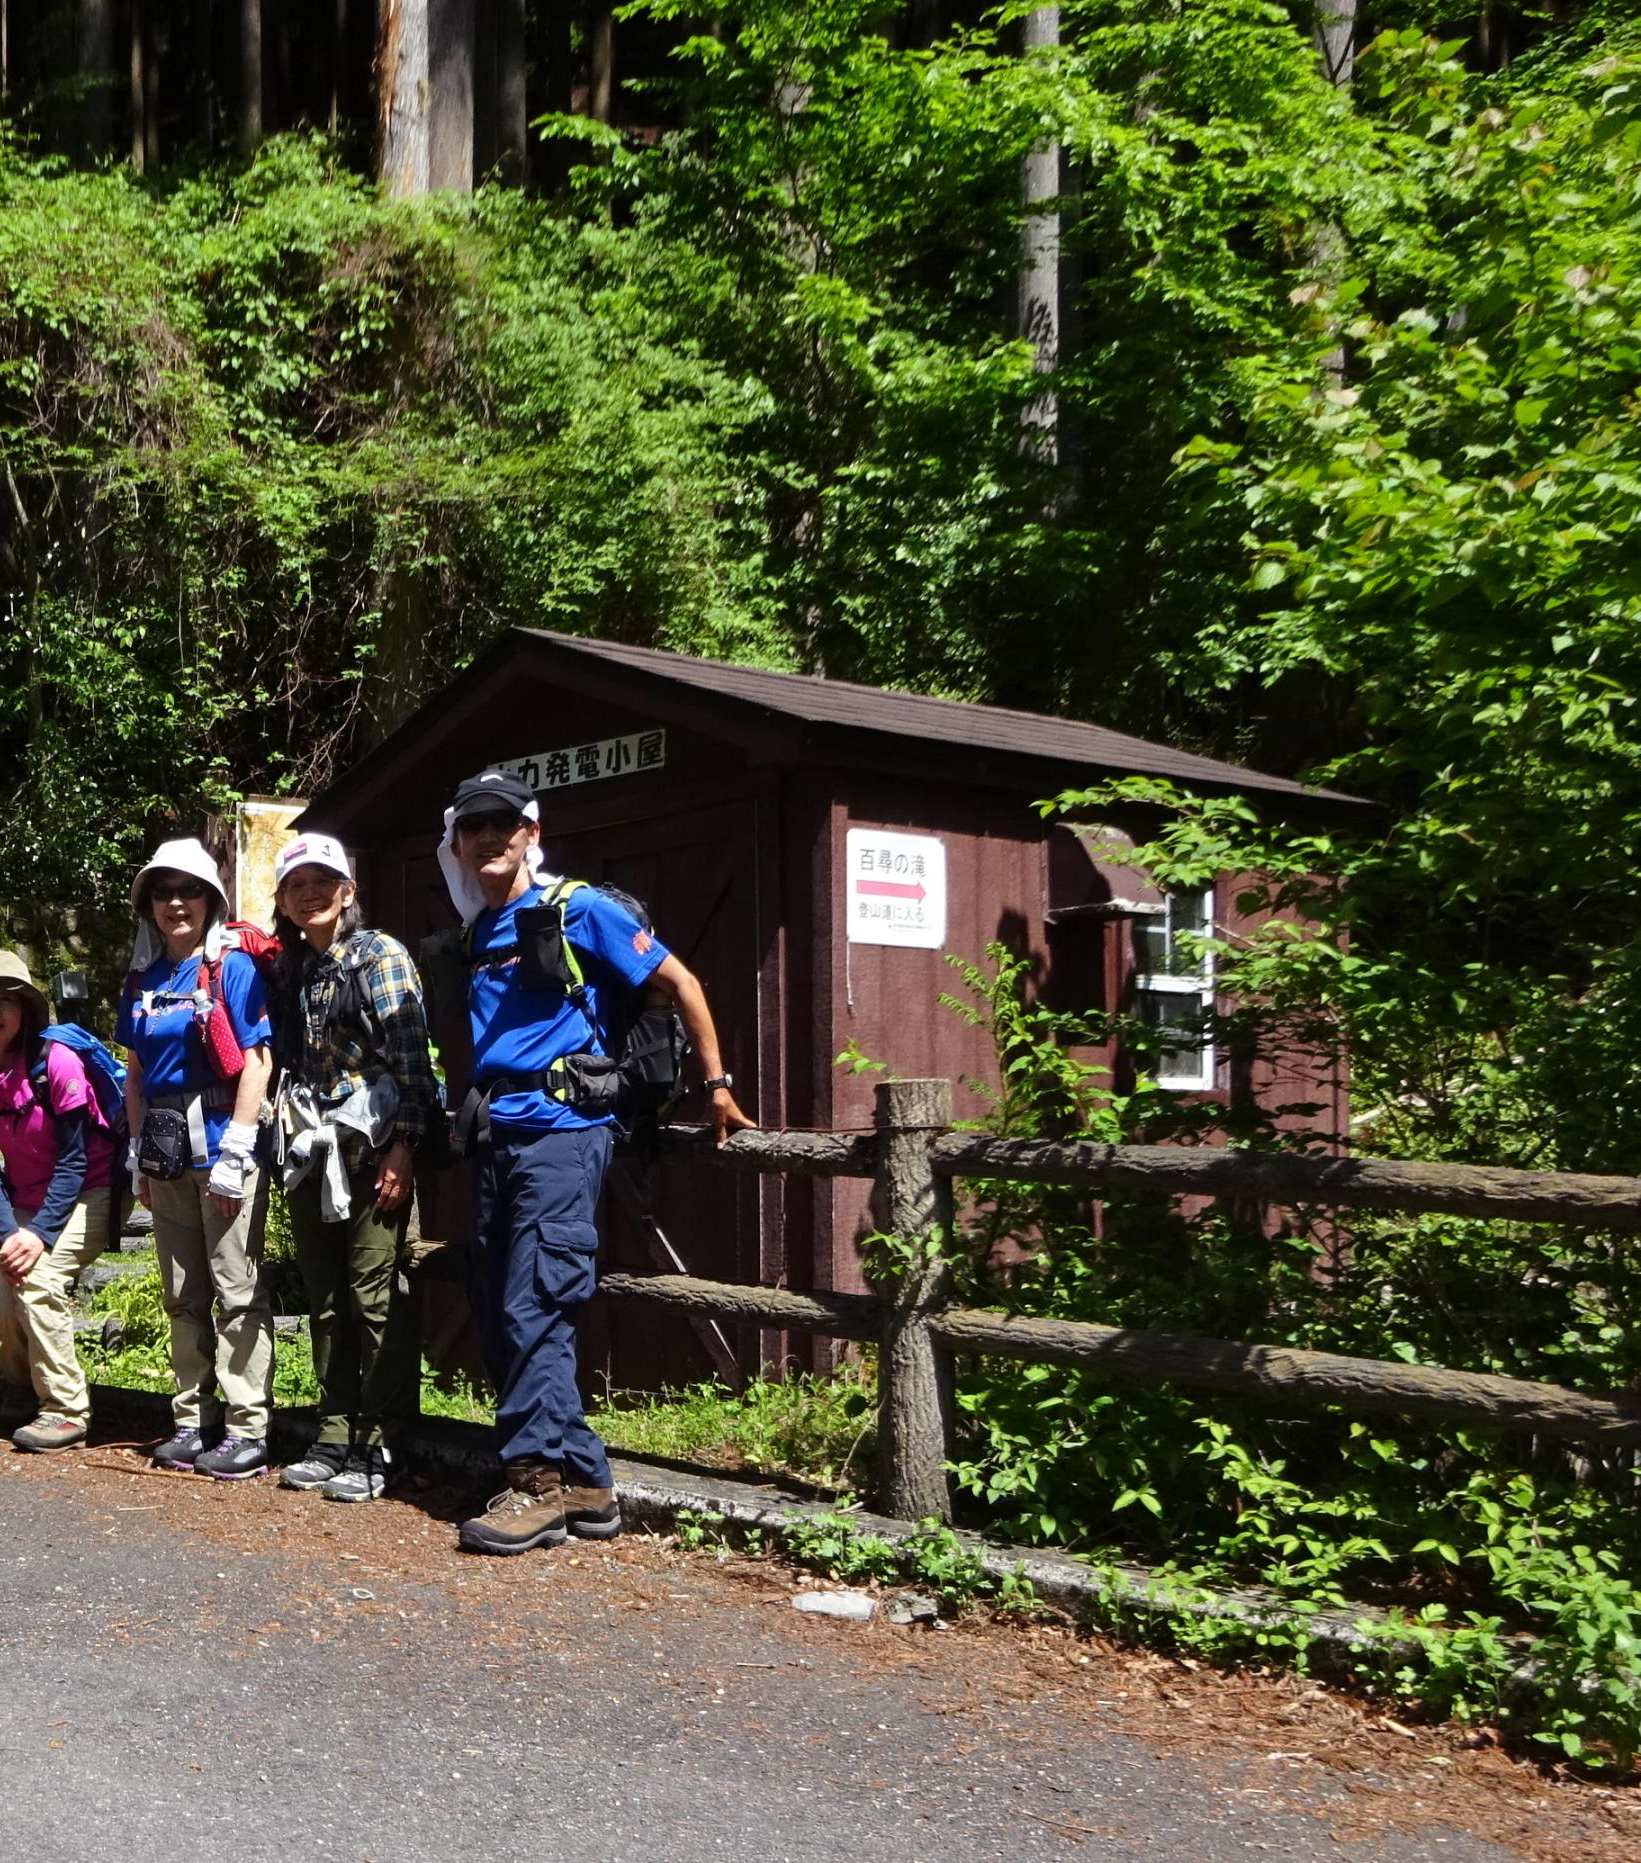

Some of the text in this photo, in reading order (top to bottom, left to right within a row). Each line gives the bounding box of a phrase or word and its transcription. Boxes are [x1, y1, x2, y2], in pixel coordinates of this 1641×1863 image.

[859, 848, 927, 878] 百尋の滝
[858, 901, 925, 923] 登山道に入る
